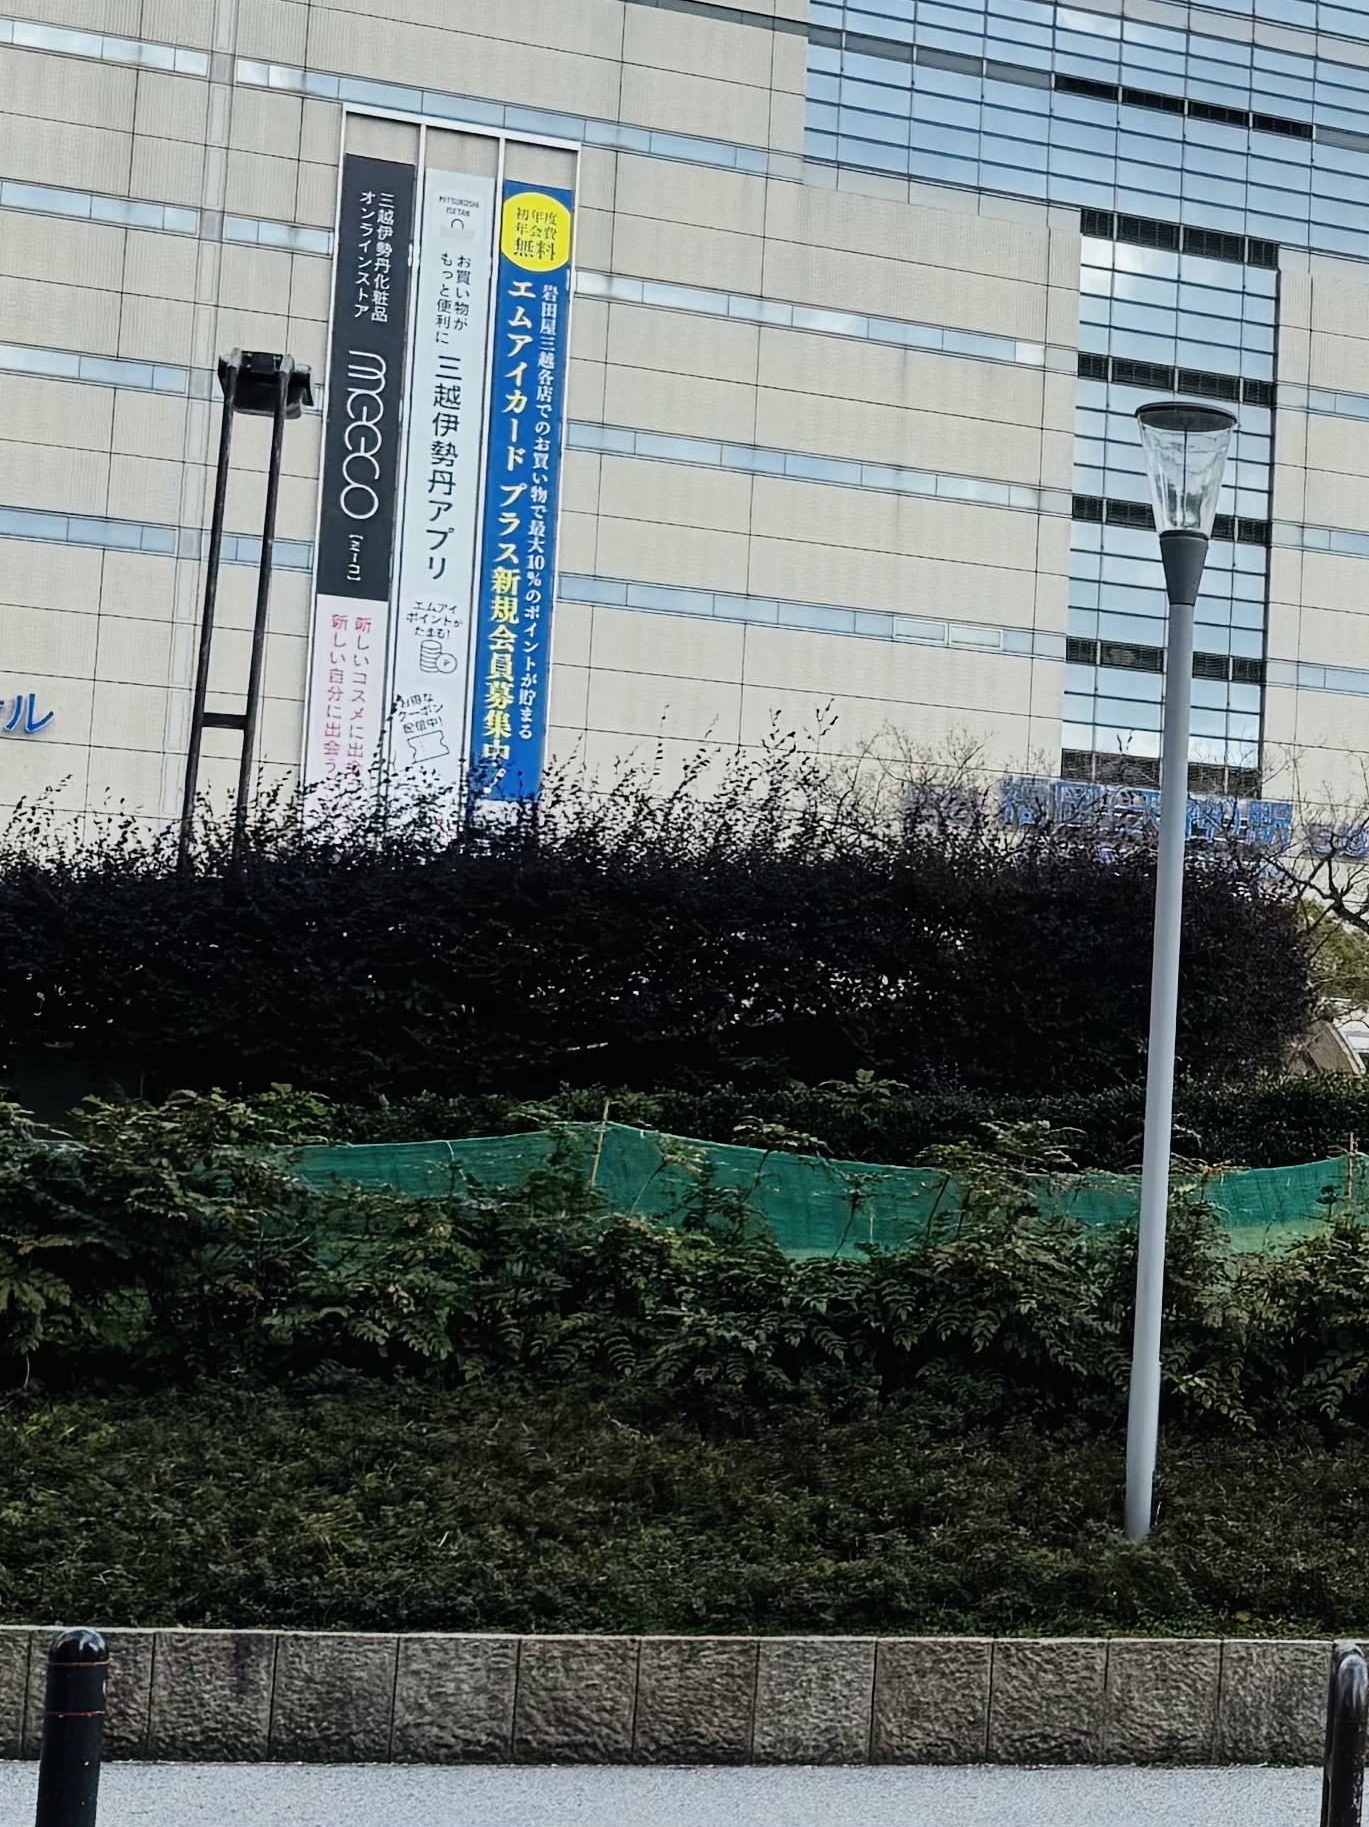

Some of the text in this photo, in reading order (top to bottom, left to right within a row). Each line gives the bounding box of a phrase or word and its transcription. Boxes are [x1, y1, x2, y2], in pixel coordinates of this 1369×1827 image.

[354, 191, 376, 318] オンラインストア
[371, 192, 395, 323] 三越伊勢丹化粧品
[513, 237, 556, 261] 無料
[515, 221, 557, 241] 年会費
[516, 207, 557, 226] 初年度
[435, 252, 454, 345] もっと便利に
[453, 255, 472, 331] お買い物が
[340, 349, 387, 520] meeco
[426, 355, 462, 580] 三越伊勢丹アプリ
[0, 692, 55, 734] ル
[323, 614, 348, 774] 新しい自分に出会う
[346, 617, 372, 784] 新しいコスメに出会
